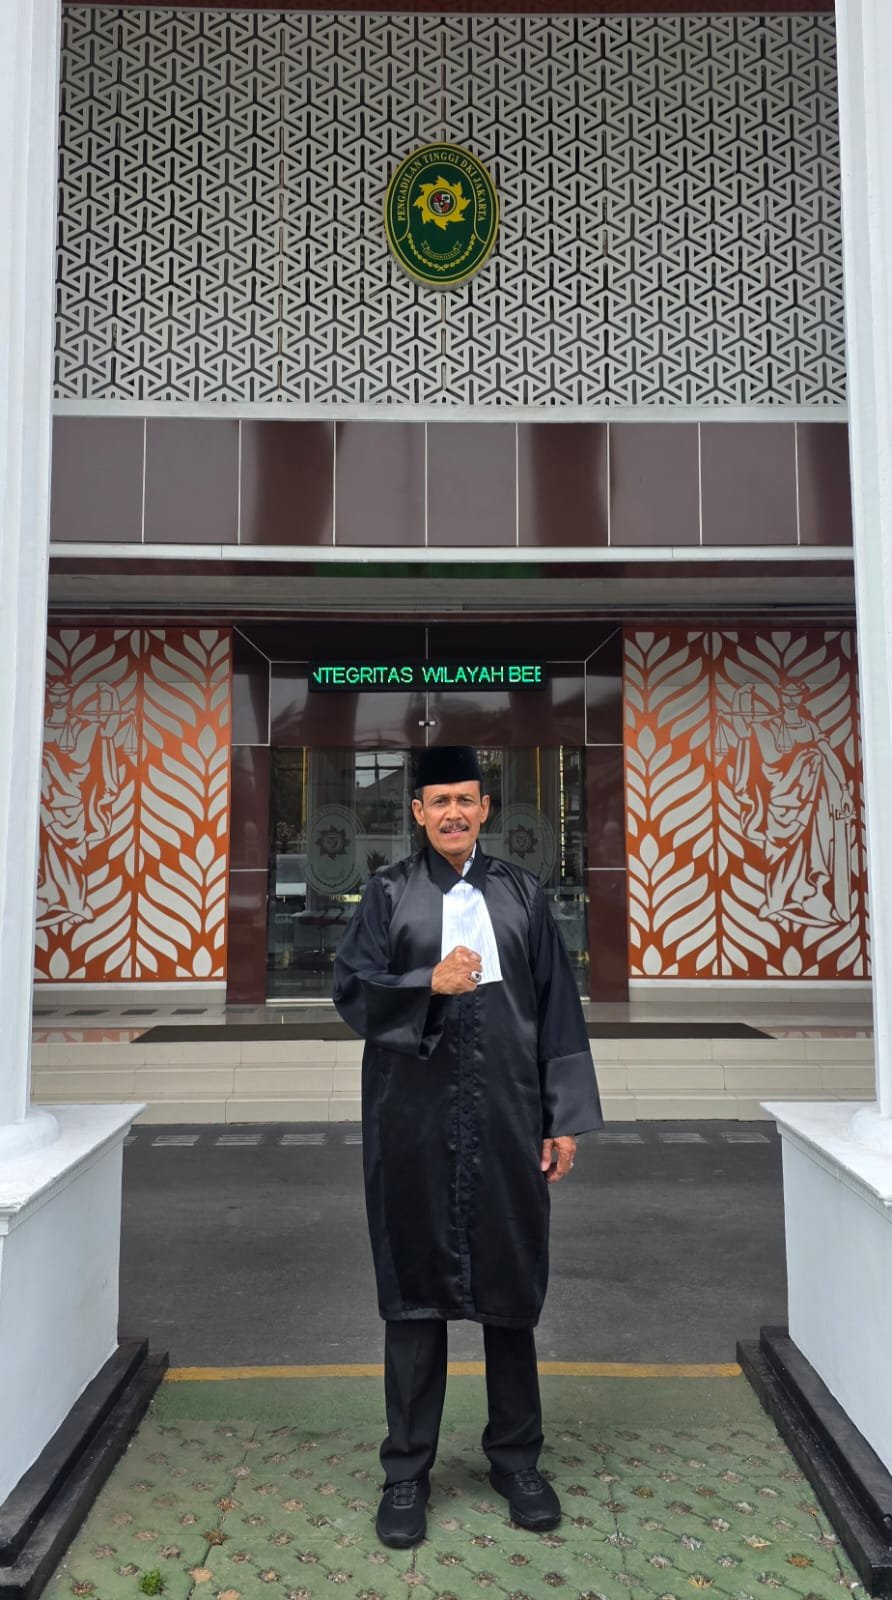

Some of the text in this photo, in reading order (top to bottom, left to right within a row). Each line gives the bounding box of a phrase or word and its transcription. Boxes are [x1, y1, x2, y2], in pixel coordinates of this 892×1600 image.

[397, 152, 487, 222] PENGADILAN TINGGI DKI JAKARTA
[422, 666, 503, 683] WILAYAH
